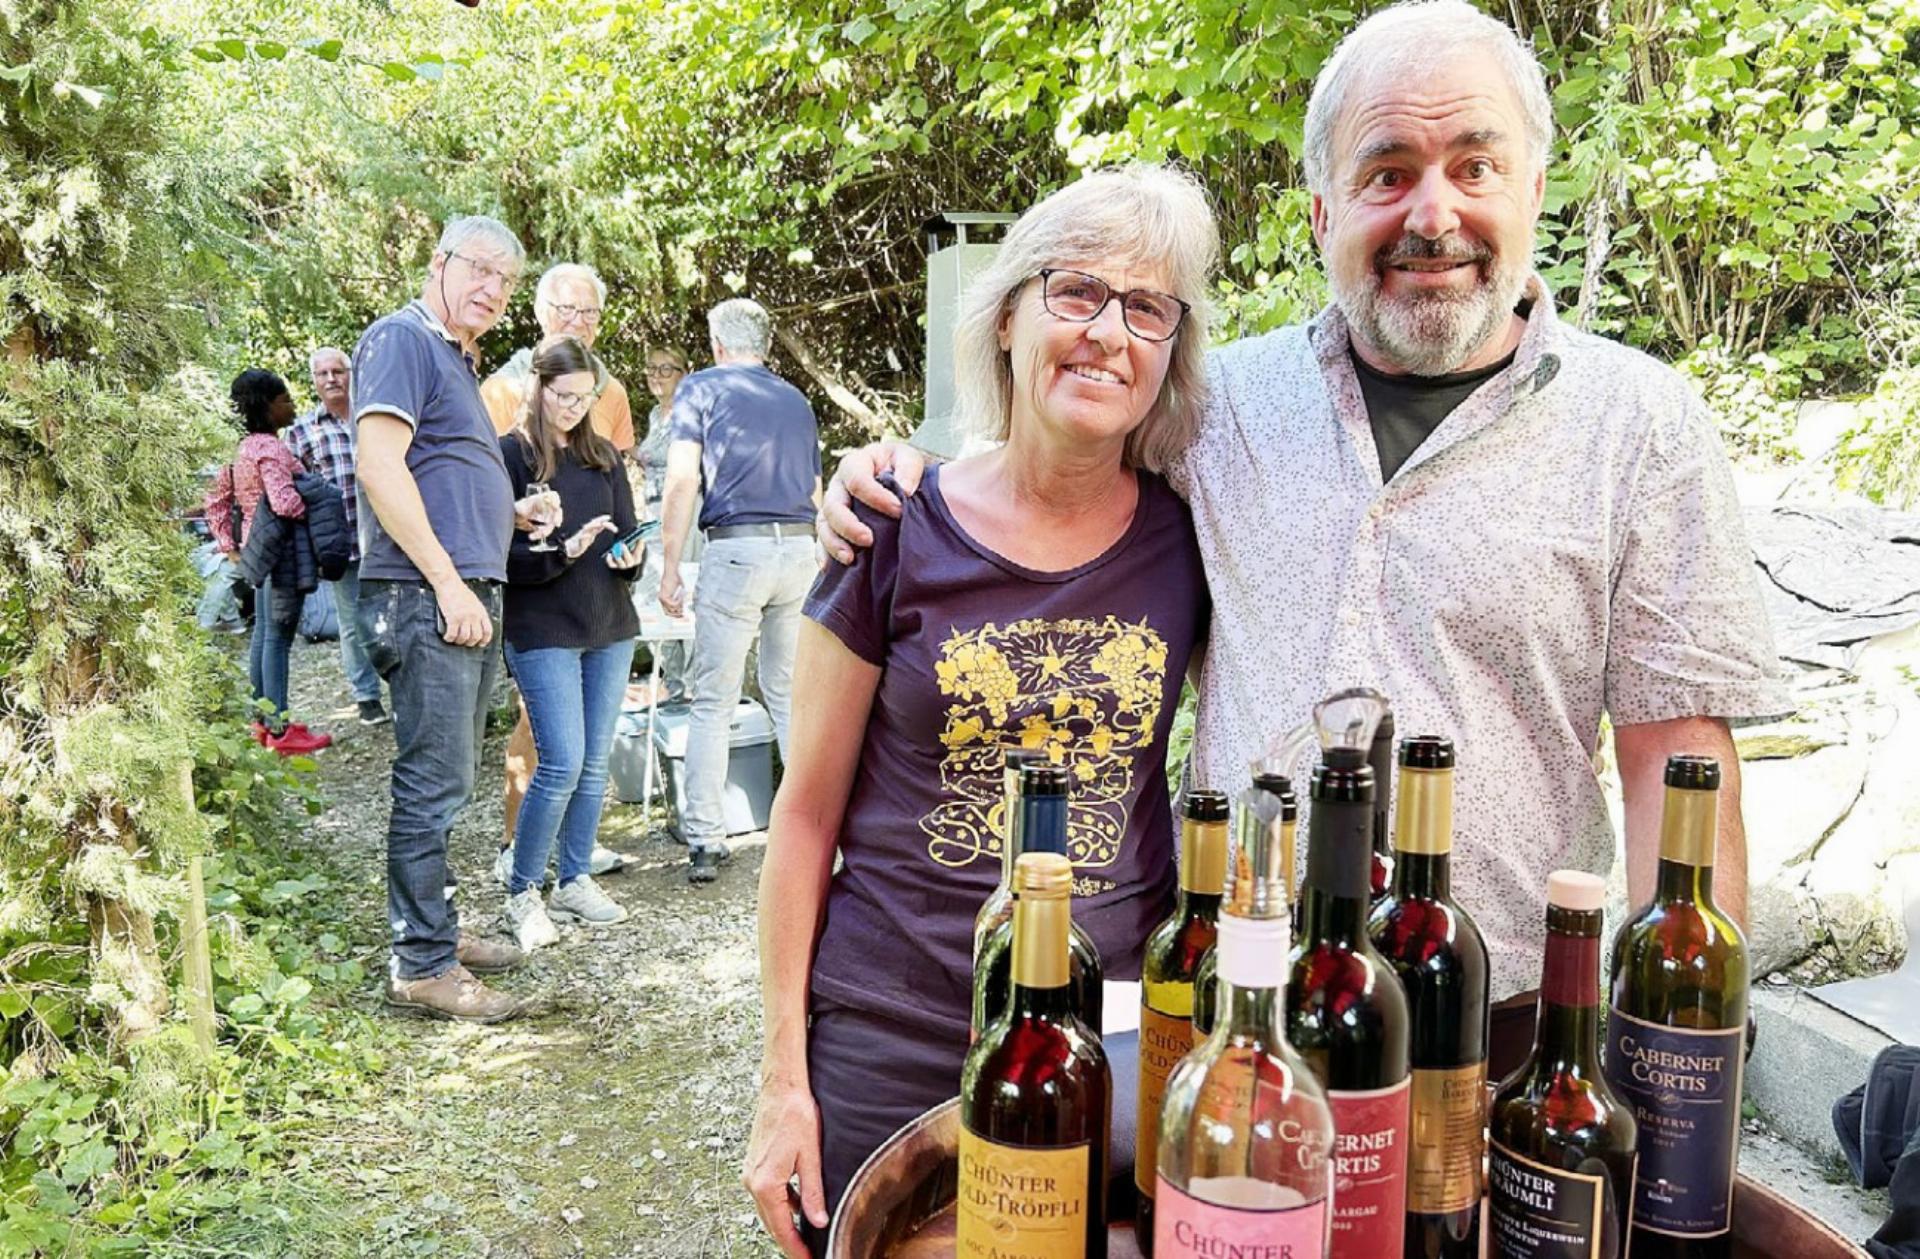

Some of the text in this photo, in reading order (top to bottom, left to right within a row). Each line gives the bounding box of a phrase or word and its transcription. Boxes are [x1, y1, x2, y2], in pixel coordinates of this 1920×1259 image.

[1620, 1036, 1724, 1072] CABERNET
[1631, 1061, 1706, 1092] CORTIS
[1637, 1106, 1695, 1129] RESERVA
[964, 1152, 1057, 1194] CHÜNTER
[1174, 1220, 1293, 1259] CHÜNTER
